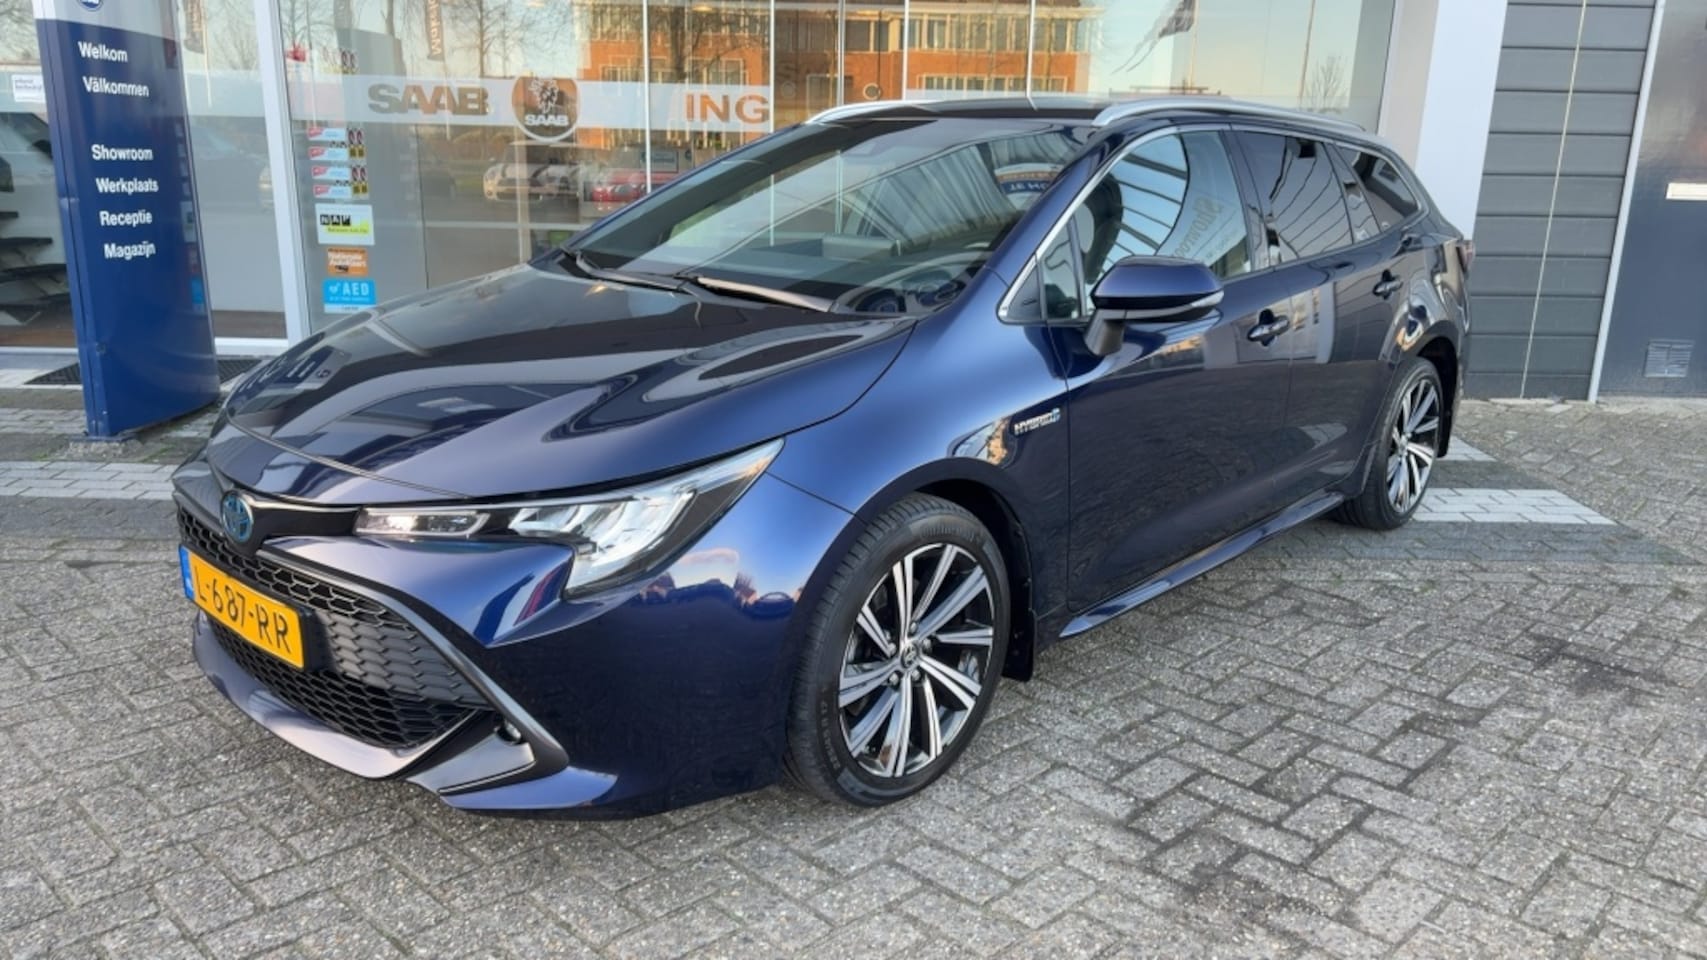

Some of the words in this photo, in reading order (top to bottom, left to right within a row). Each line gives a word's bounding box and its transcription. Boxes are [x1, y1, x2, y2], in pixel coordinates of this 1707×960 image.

[78, 41, 128, 62] Welkom
[82, 76, 149, 97] Välkommen
[368, 82, 489, 117] SAAB
[684, 93, 770, 124] ING
[524, 113, 569, 127] SAAB
[91, 144, 153, 161] Showroom
[96, 177, 158, 195] Werkplaats
[100, 209, 152, 227] Receptie
[104, 241, 156, 260] Magazijn
[342, 282, 369, 296] AED
[194, 565, 291, 654] L-687-RR
